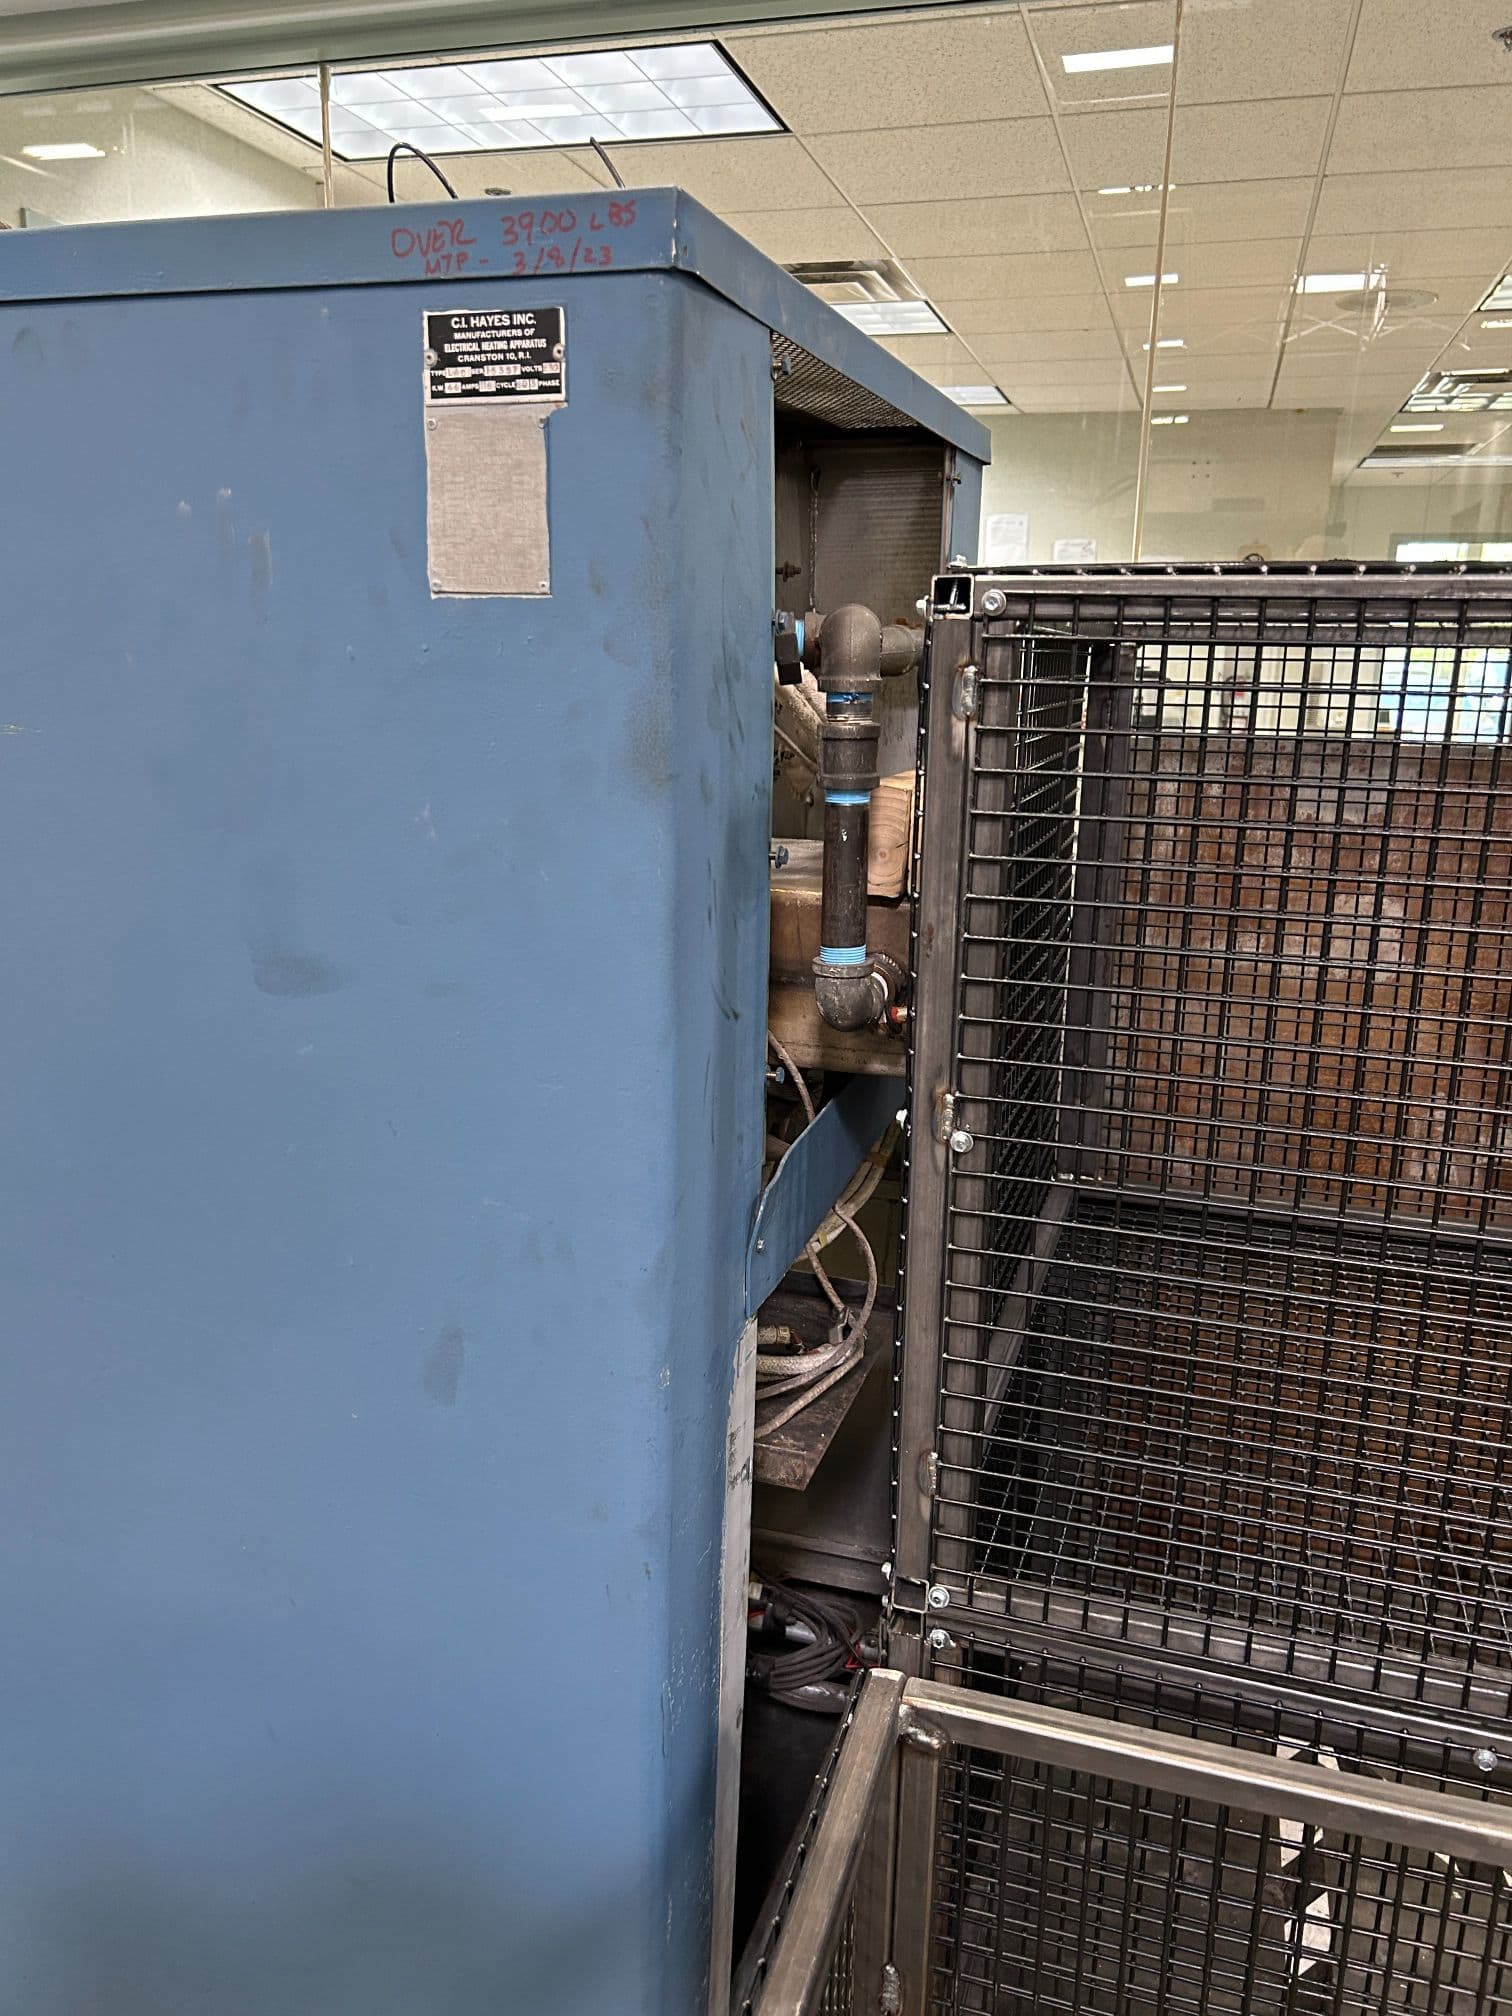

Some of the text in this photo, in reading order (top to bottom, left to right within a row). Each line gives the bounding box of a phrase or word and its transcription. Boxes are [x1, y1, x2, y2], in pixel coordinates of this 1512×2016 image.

[391, 218, 476, 258] OVER
[500, 208, 577, 247] 3900
[451, 313, 537, 329] C.I. HAYES INC.
[453, 328, 536, 340] MANUFACTURERS OF
[444, 338, 547, 353] ELECTRICAL HEATING APPARATUS
[457, 353, 504, 363] CRANSTON
[430, 369, 446, 377] TYPE
[521, 365, 543, 373] VOLTS
[538, 379, 560, 387] PHASE
